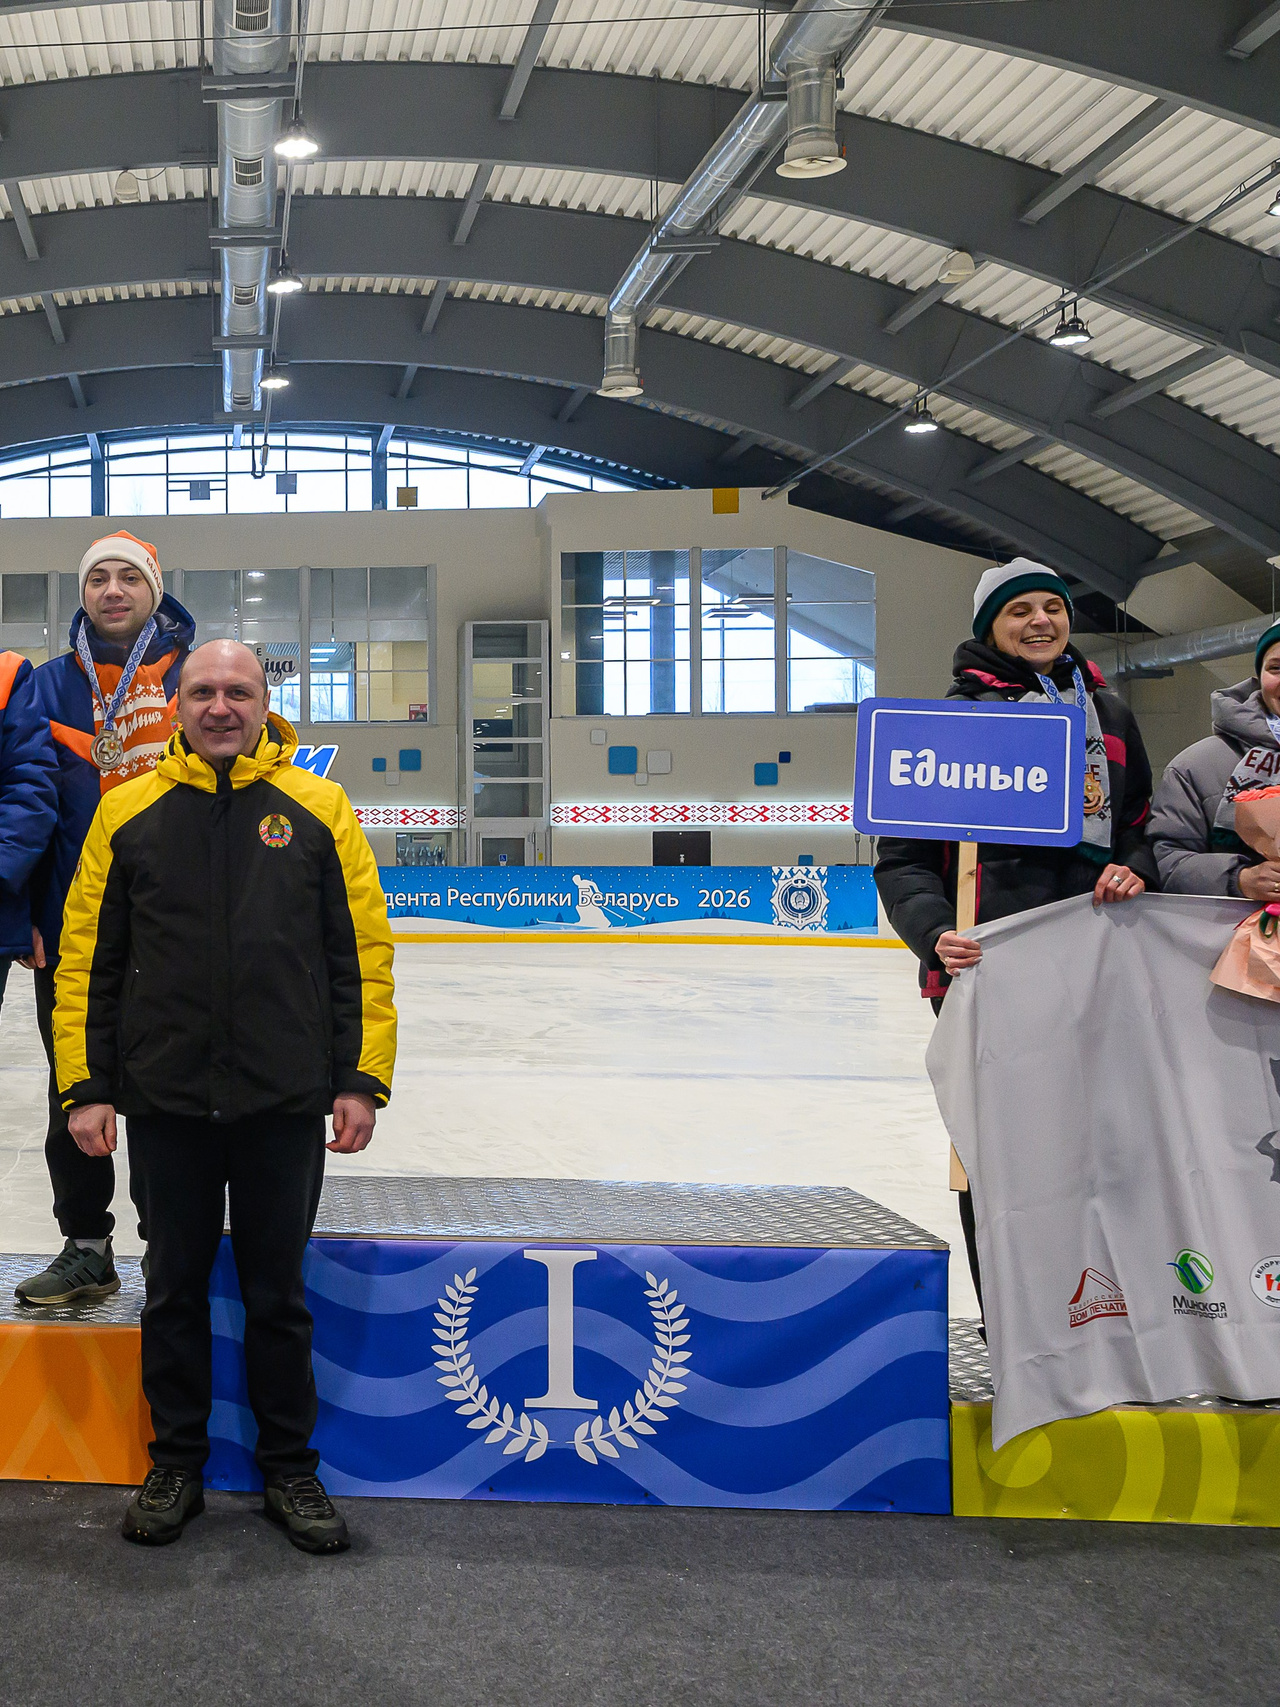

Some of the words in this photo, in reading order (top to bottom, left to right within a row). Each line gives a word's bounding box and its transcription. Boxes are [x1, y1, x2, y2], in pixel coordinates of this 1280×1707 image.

[889, 748, 1049, 793] Единые
[446, 887, 572, 911] Республики
[577, 887, 680, 911] Беларусь
[698, 888, 751, 908] 2026
[523, 1249, 598, 1410] I
[1070, 1310, 1088, 1323] ДОМ
[1090, 1302, 1127, 1315] ПЕЧАТИ
